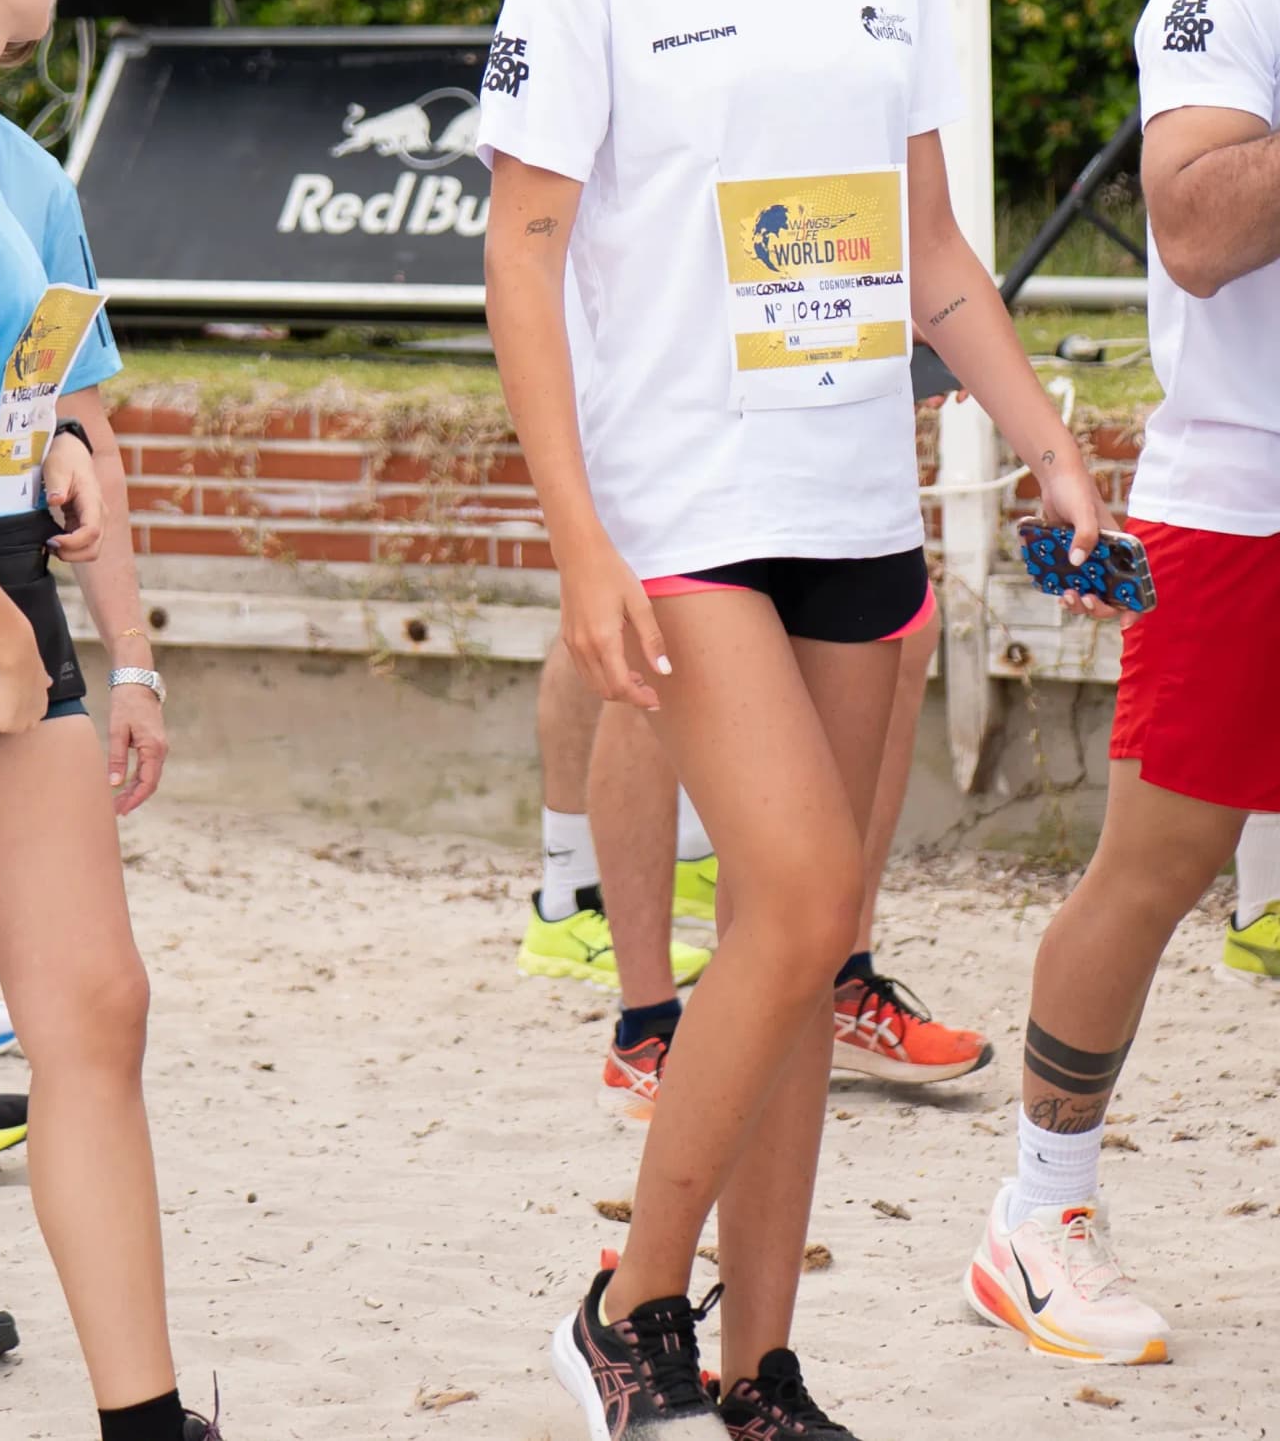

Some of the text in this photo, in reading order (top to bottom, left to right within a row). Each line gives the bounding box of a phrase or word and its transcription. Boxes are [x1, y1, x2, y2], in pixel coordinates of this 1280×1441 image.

[1163, 15, 1215, 36] PROP
[652, 25, 738, 54] ARUNCINA
[1162, 32, 1207, 53] .COM
[276, 170, 490, 238] Red Bu
[789, 216, 831, 231] WINGS
[796, 229, 819, 242] LIFE
[773, 237, 871, 267] WORLD RUN
[735, 285, 757, 297] NOME
[756, 280, 805, 296] COSTANZA
[819, 277, 856, 291] COGNOME
[764, 302, 783, 324] N°
[788, 335, 801, 347] KM
